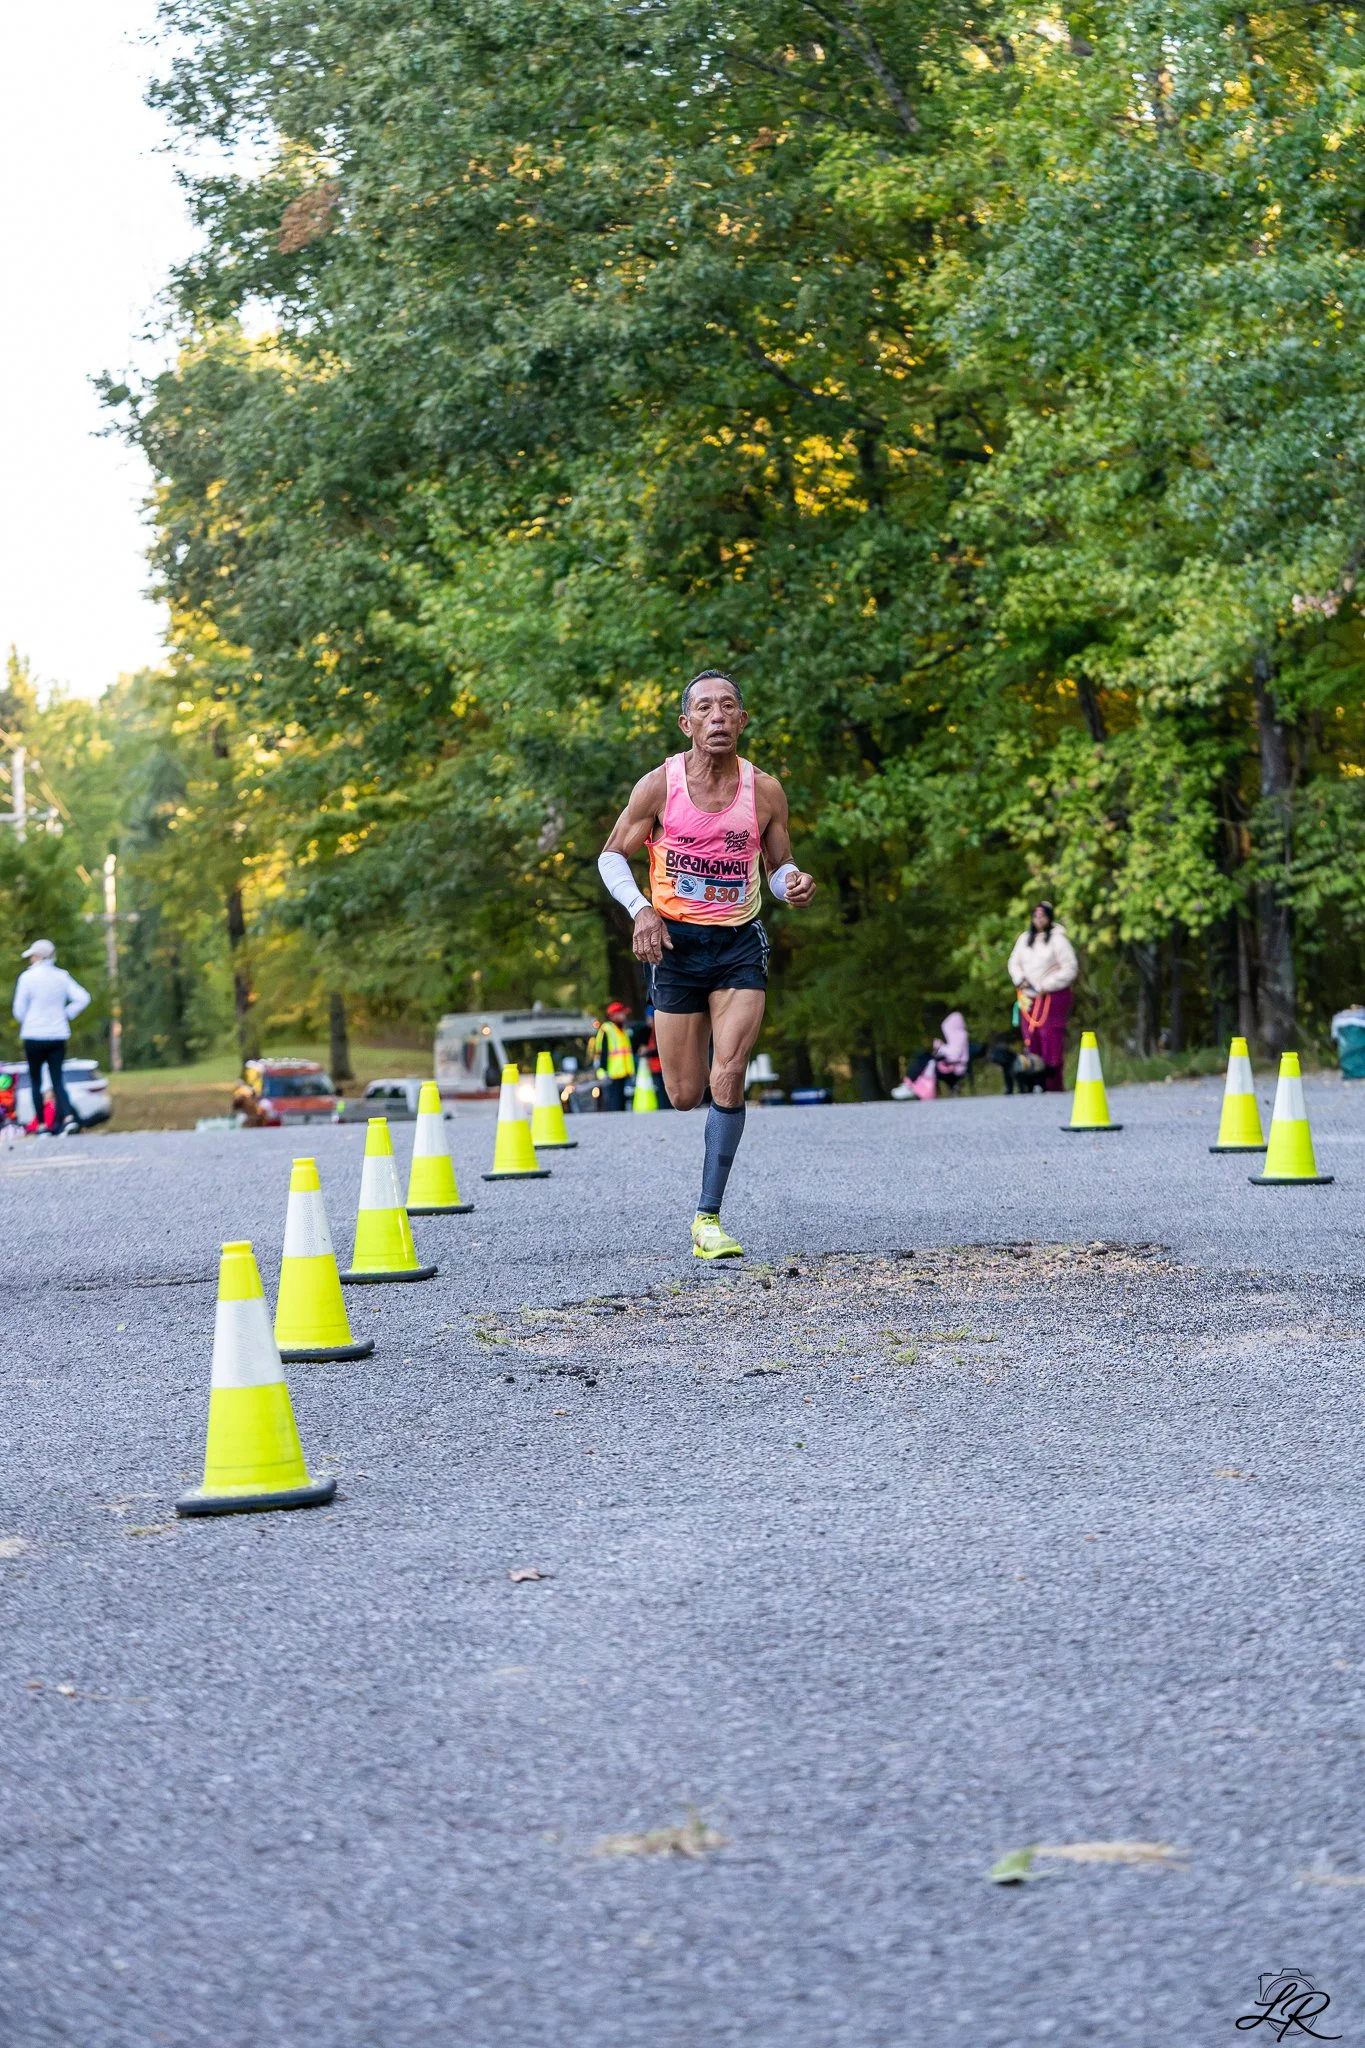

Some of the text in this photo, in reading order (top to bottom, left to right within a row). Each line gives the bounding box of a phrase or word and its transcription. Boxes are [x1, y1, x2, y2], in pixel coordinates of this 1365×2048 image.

[724, 830, 750, 843] Party
[666, 850, 749, 880] Breakaway
[704, 886, 740, 903] 830
